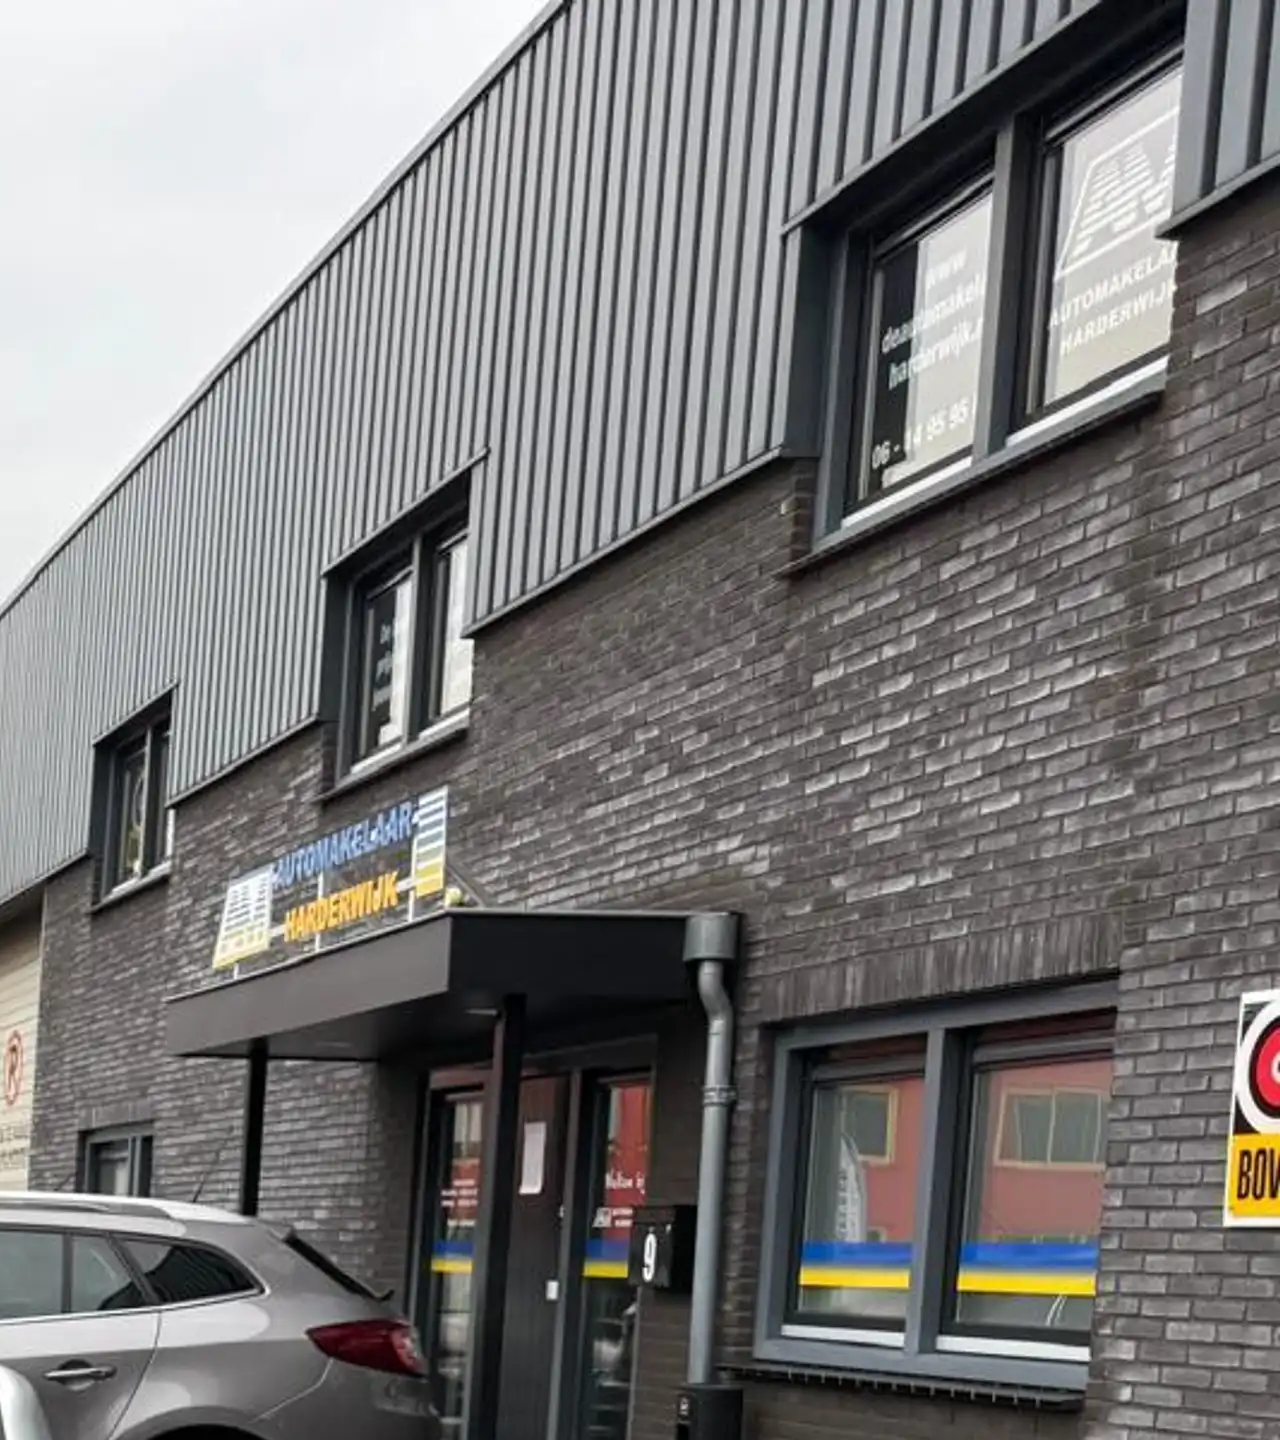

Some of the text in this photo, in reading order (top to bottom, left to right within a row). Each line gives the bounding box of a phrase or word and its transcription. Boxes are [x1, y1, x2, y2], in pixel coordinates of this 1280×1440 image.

[273, 802, 413, 890] AUTOMAKELAAR
[284, 871, 399, 942] HARDERWIJK
[642, 1232, 657, 1282] 9
